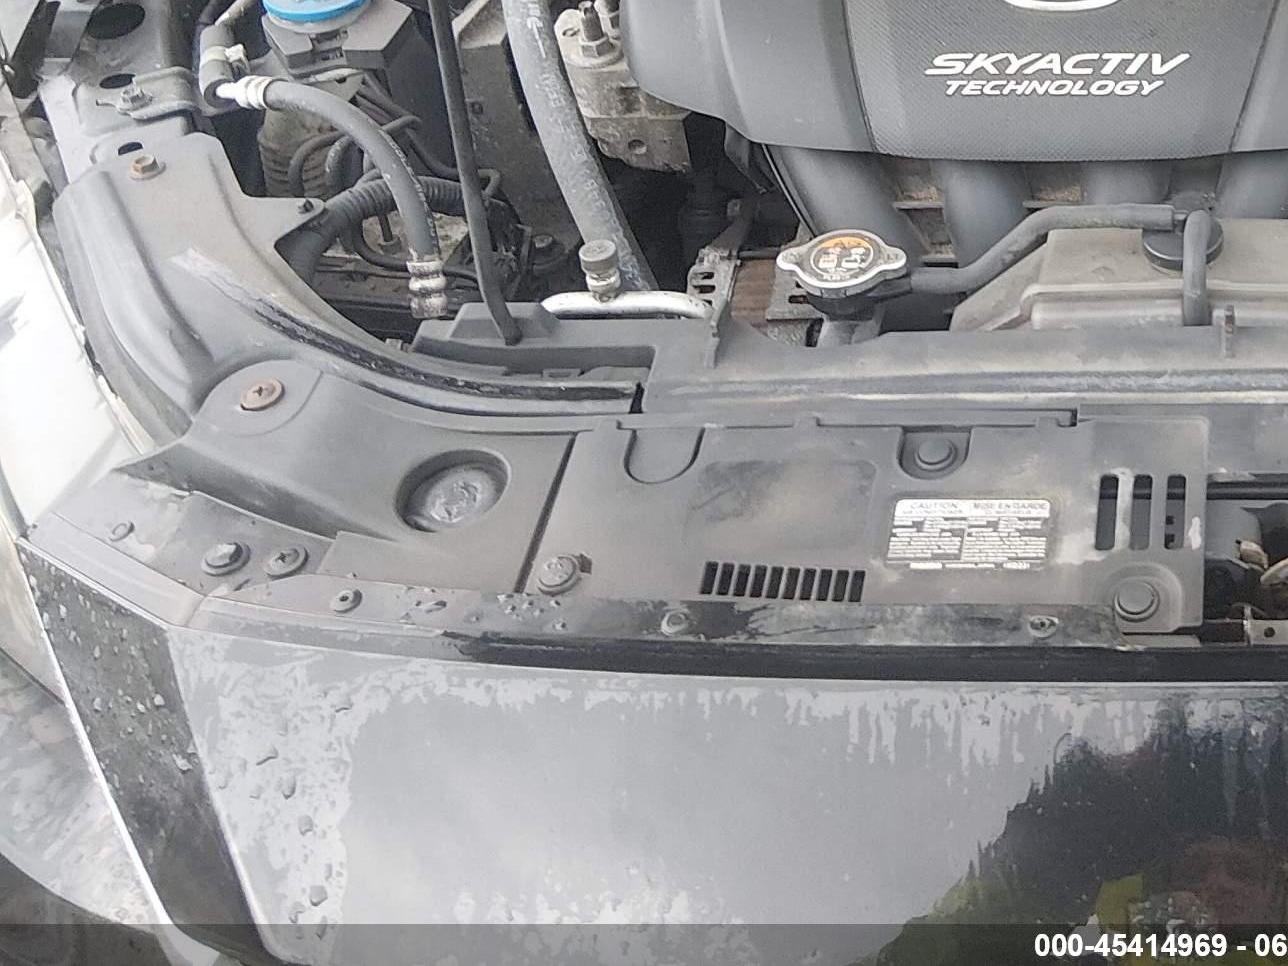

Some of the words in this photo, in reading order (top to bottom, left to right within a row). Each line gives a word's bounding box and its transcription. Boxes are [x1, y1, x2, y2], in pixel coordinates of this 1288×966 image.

[925, 53, 1189, 74] SKYACTIV
[946, 80, 1164, 95] TECHNOLOGY
[910, 501, 958, 510] CAUTION
